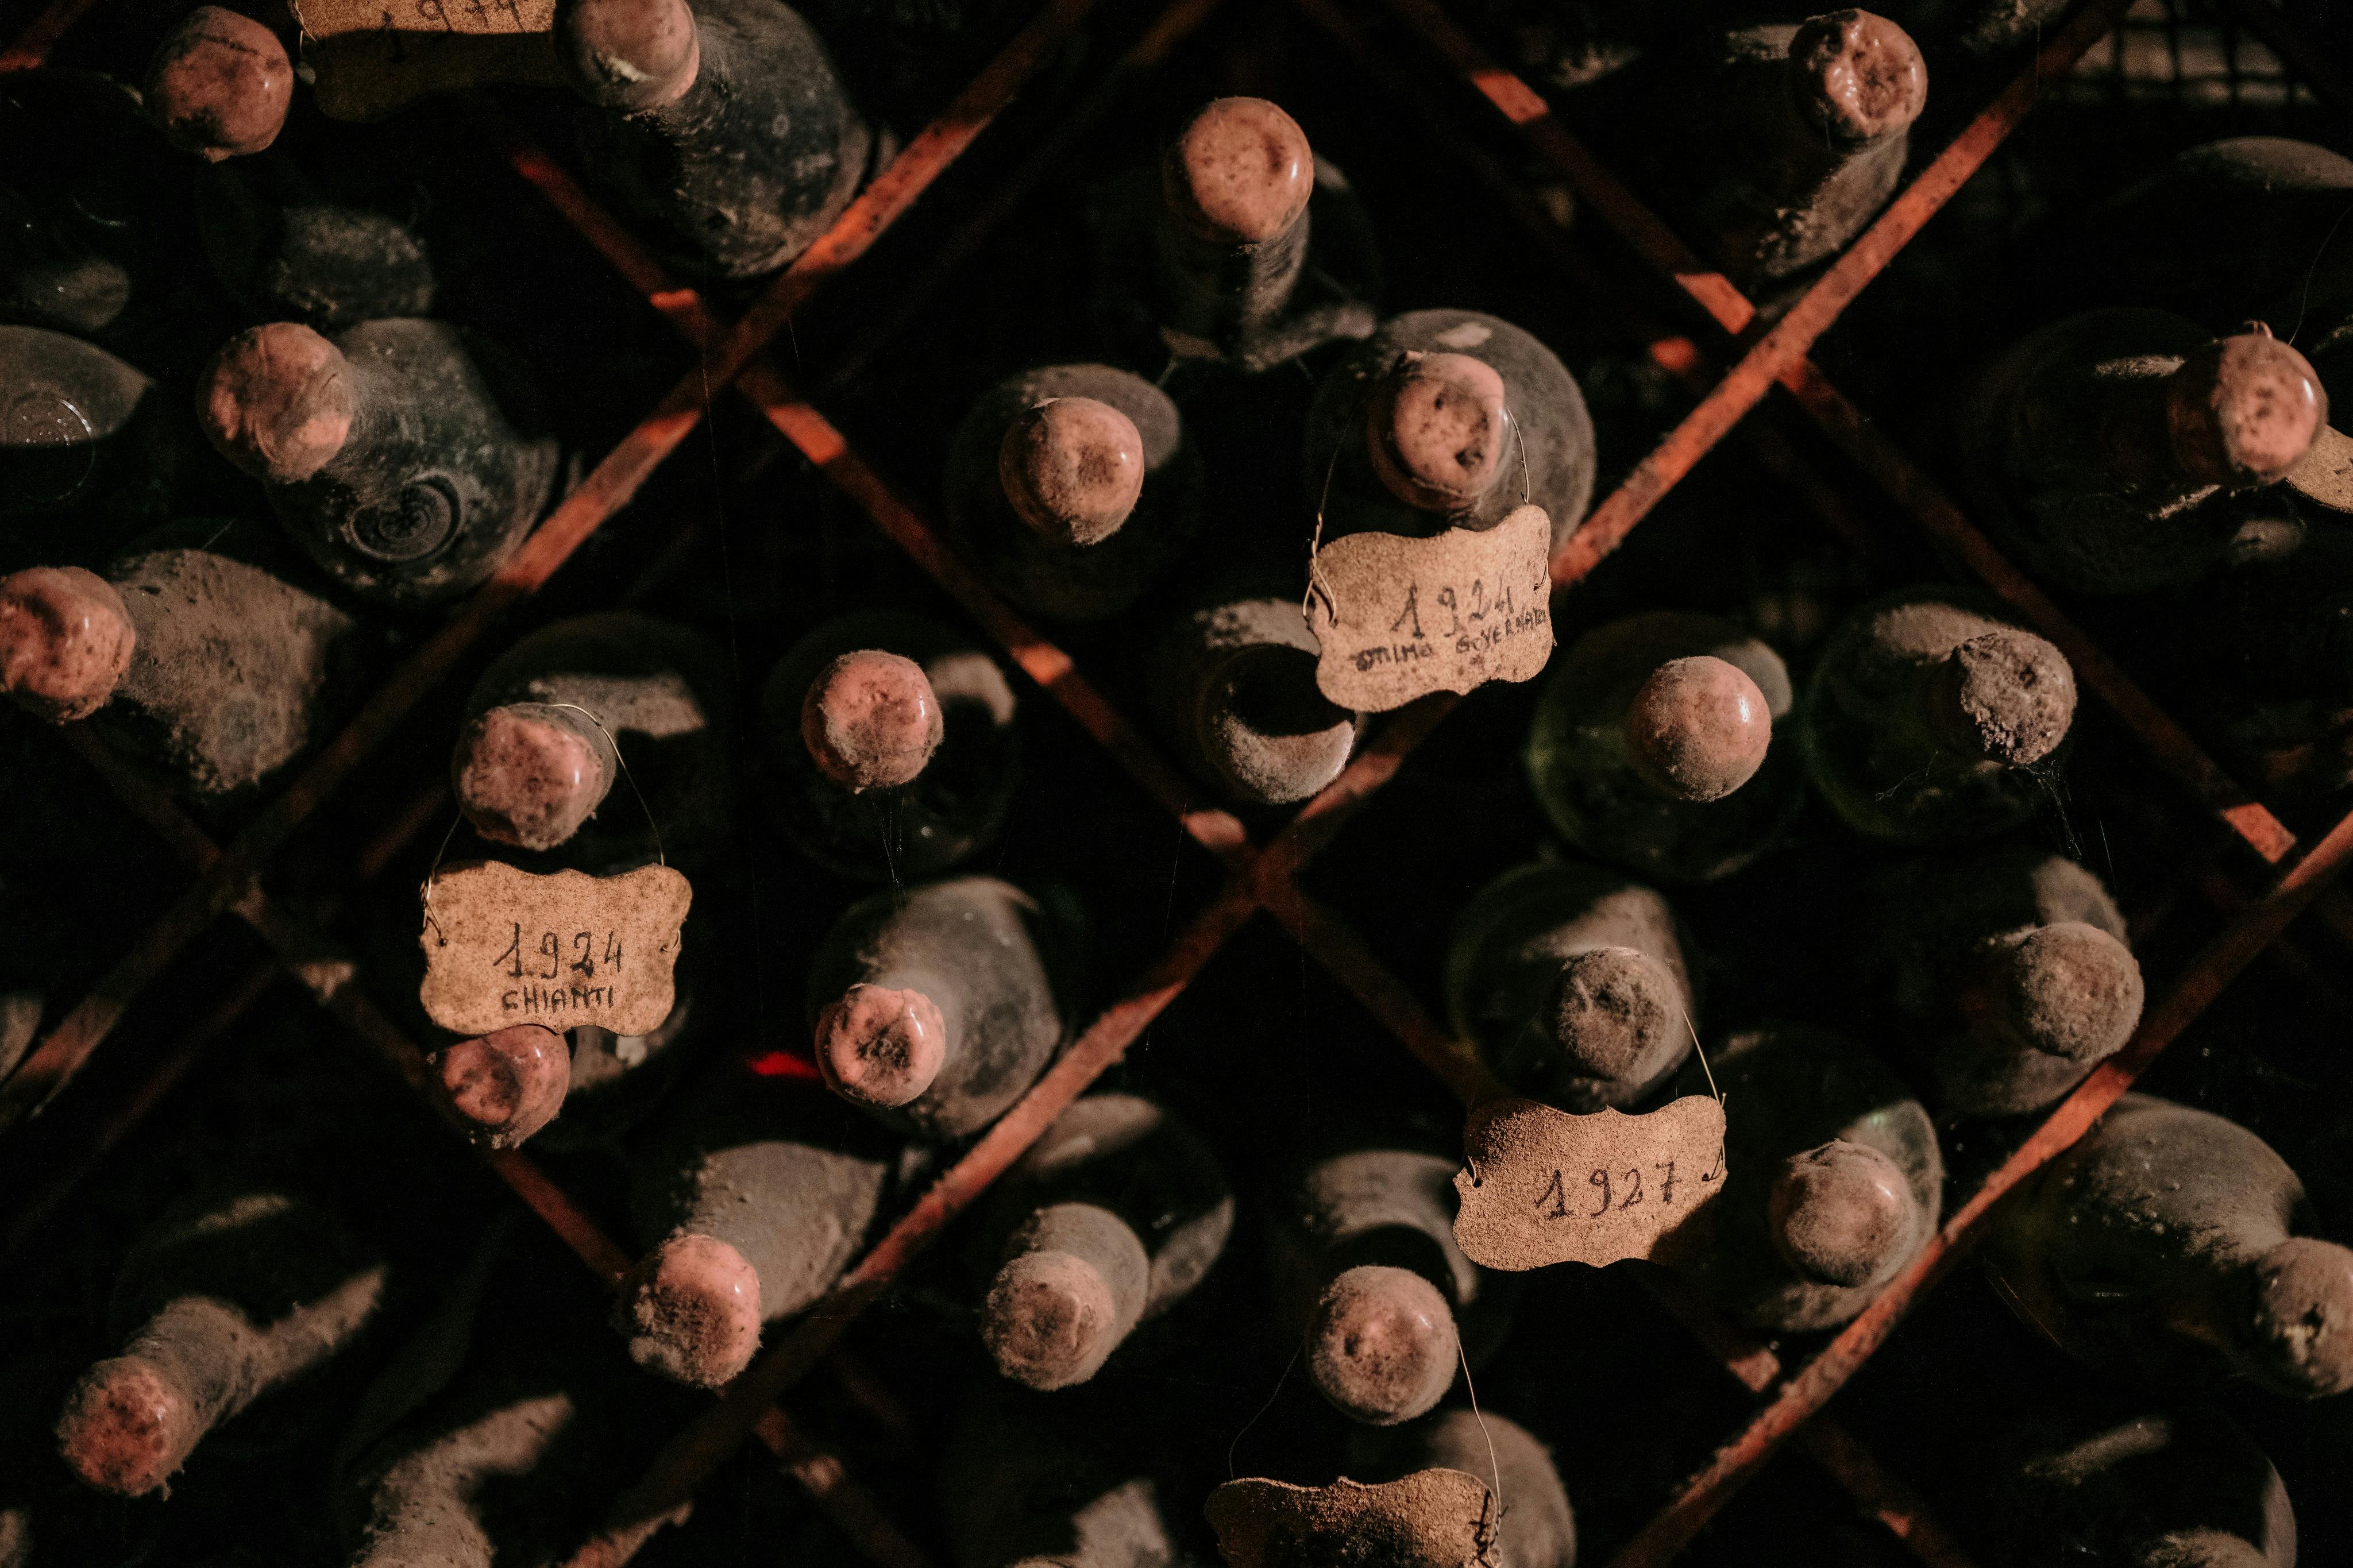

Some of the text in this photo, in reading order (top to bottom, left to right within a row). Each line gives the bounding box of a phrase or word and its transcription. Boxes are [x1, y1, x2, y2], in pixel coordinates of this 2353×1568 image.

[1390, 576, 1514, 639] 1924
[492, 922, 622, 979] 1924
[502, 985, 614, 1014] CHIANTI
[1534, 1161, 1681, 1218] 1927
